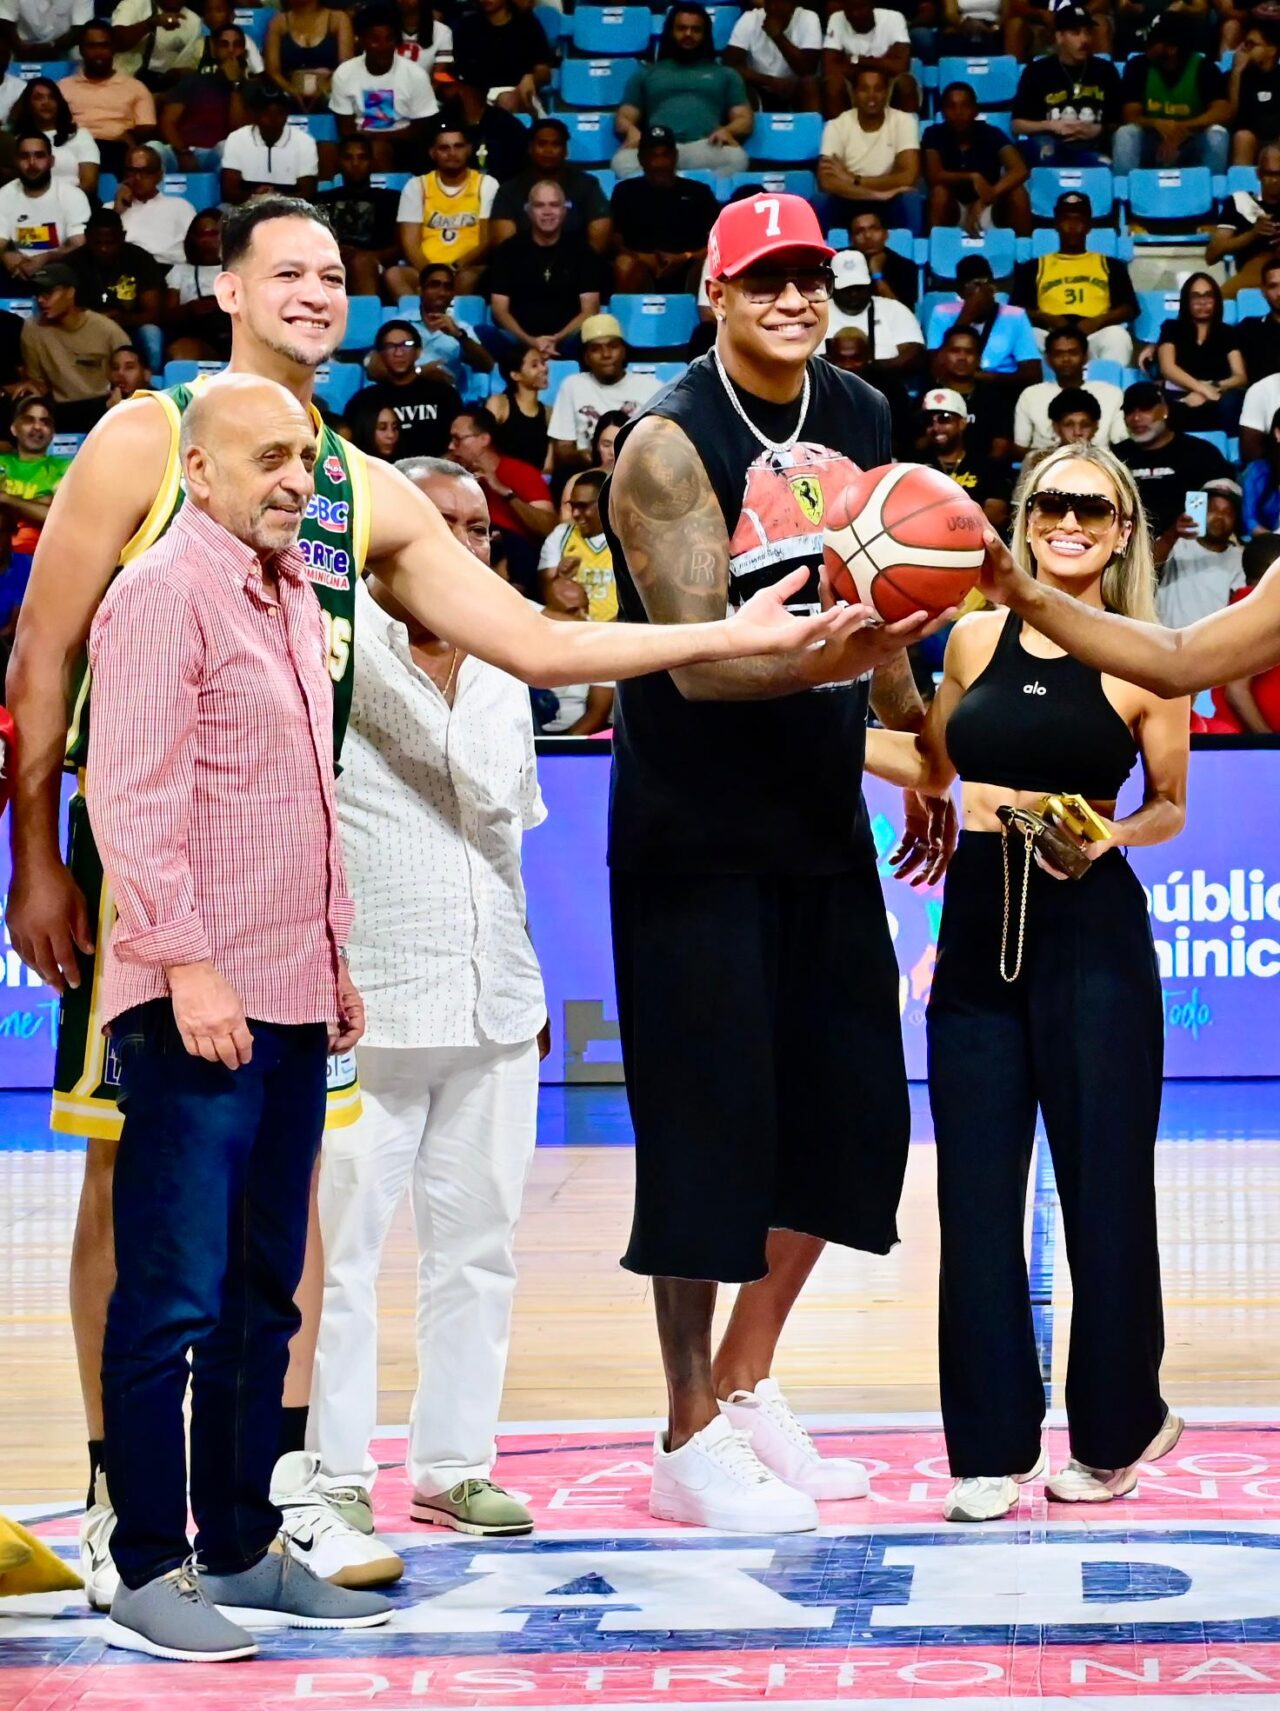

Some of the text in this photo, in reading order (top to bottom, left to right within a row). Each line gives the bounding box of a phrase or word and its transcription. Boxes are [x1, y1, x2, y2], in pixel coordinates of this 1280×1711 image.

[754, 199, 782, 237] 7
[1064, 288, 1084, 304] 31
[393, 404, 438, 421] NVIN
[1023, 680, 1047, 696] alo
[293, 1660, 1005, 1699] DISTRITO
